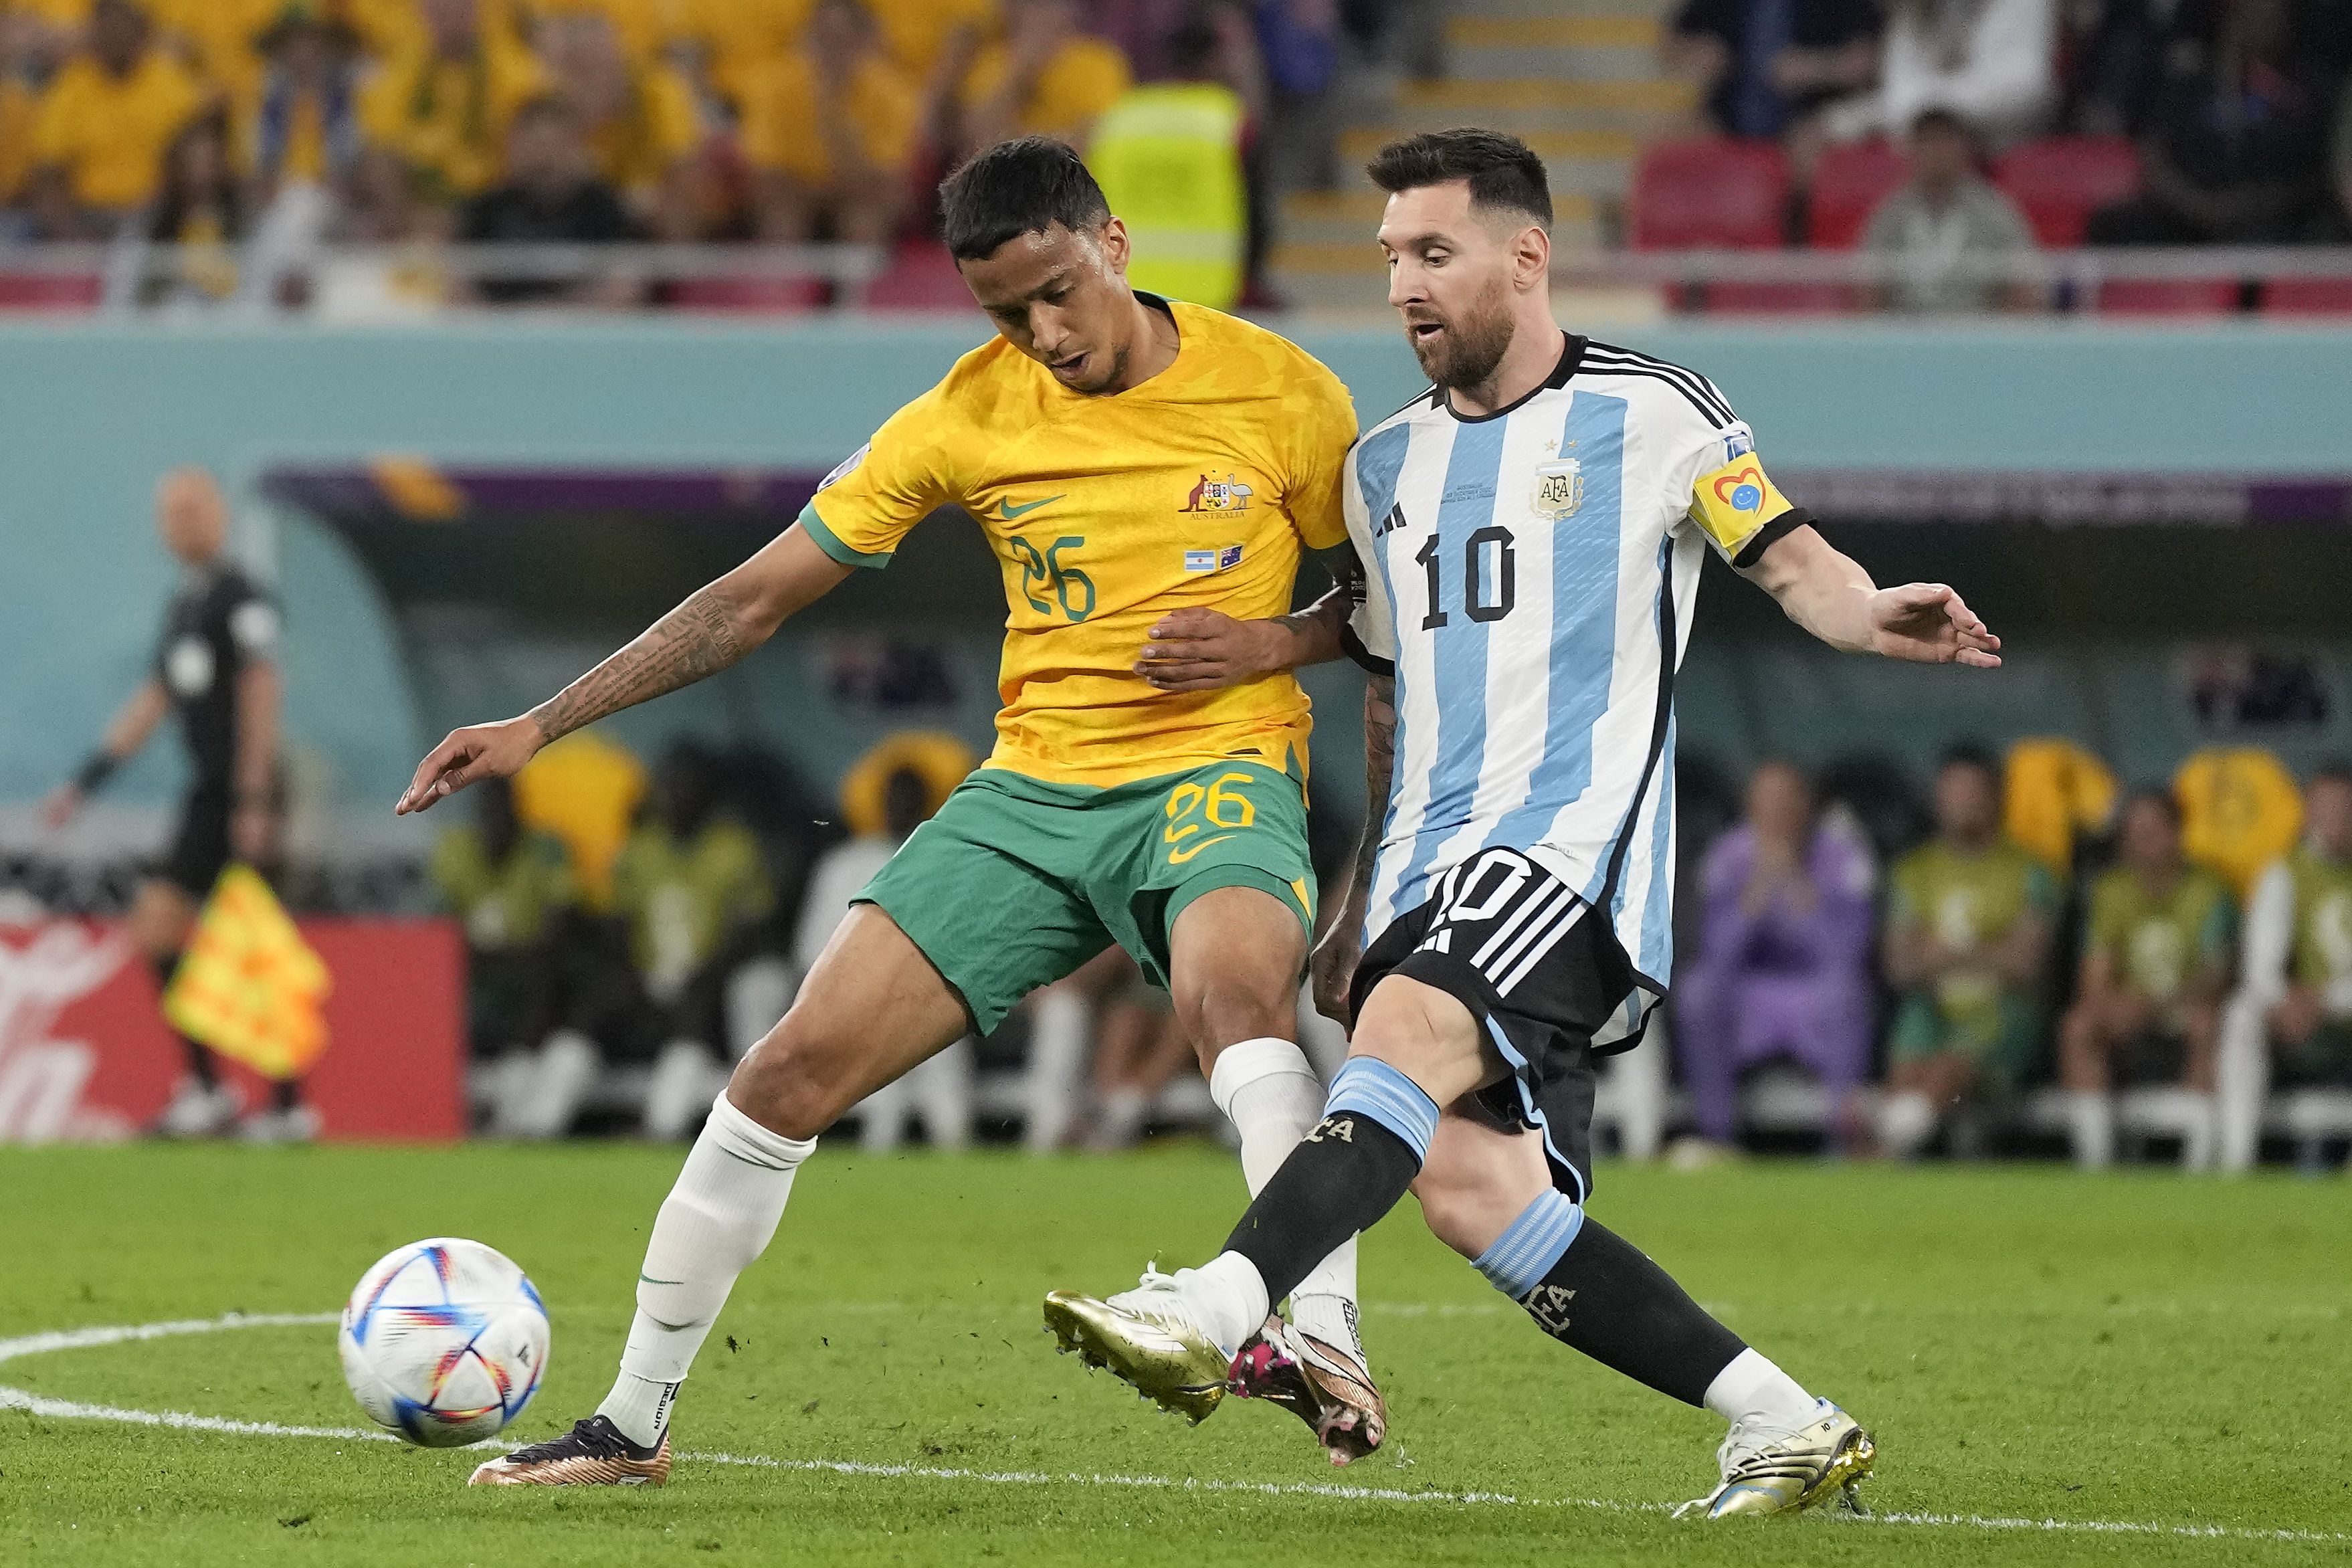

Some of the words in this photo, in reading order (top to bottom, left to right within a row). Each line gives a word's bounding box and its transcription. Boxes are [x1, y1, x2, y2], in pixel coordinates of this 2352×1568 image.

[1540, 474, 1569, 503] AFA
[1190, 510, 1246, 520] AUSTRALIA
[1011, 536, 1096, 622] 26
[1415, 526, 1514, 631] 10
[1164, 772, 1256, 843] 26
[1428, 849, 1533, 933] 10
[1301, 1116, 1354, 1143] FA
[1821, 1422, 1831, 1432] 10
